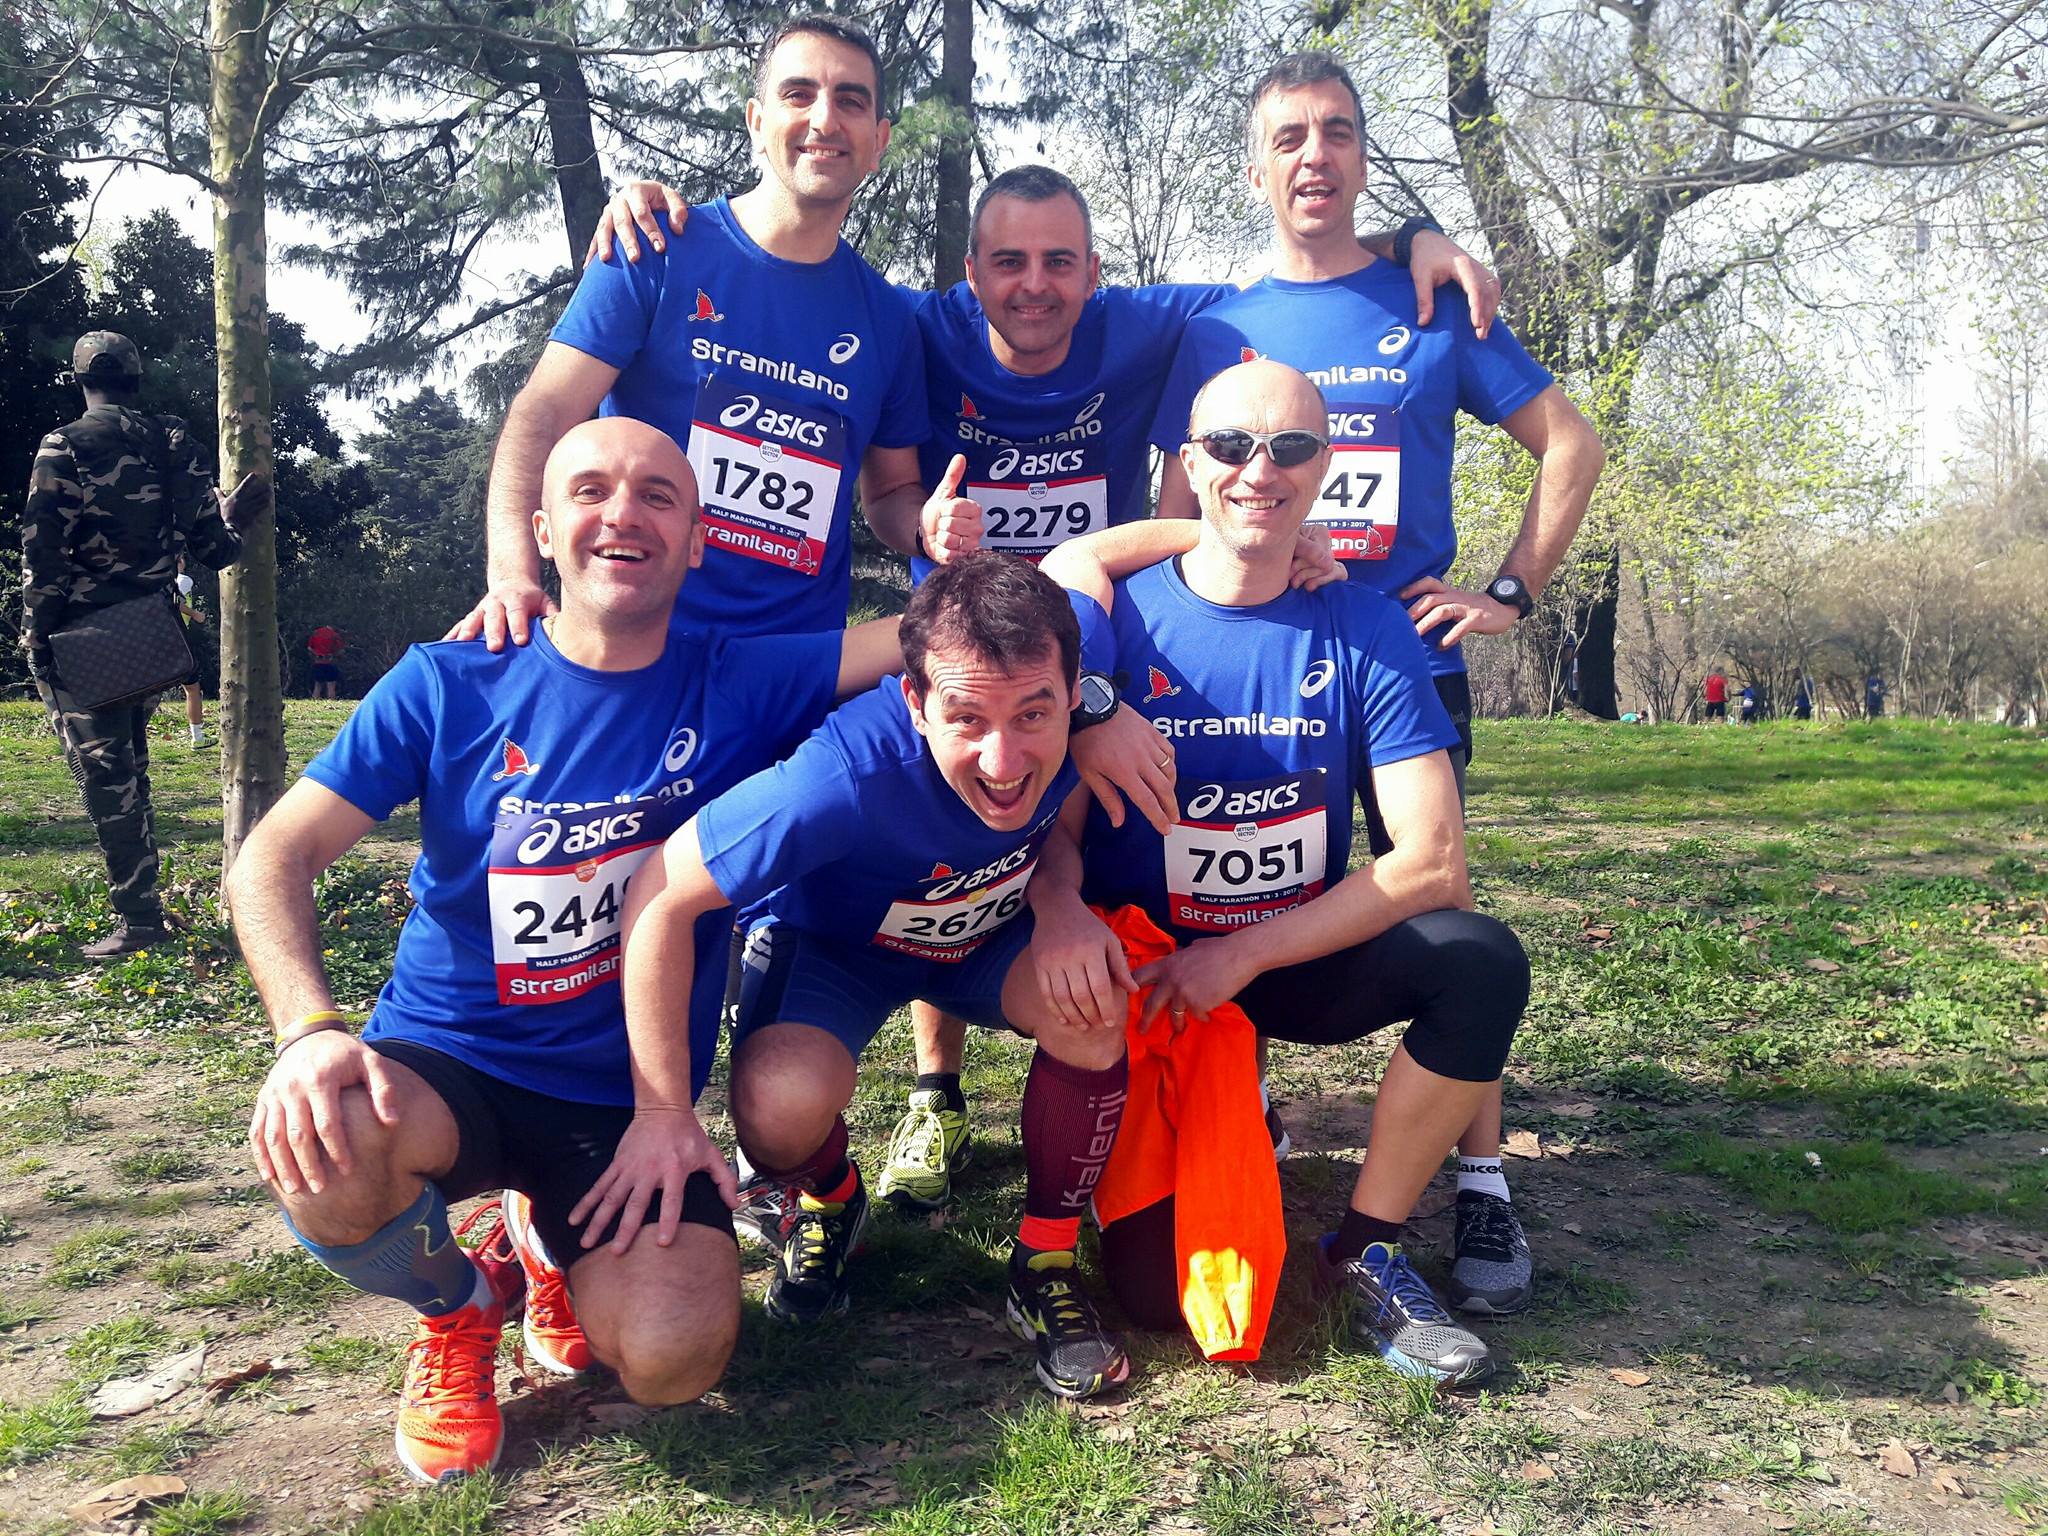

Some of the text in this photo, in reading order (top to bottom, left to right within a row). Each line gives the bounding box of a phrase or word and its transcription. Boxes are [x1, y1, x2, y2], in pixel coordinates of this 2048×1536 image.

[691, 337, 849, 401] Stramilano
[1304, 365, 1407, 386] milano
[755, 406, 828, 448] asics
[1327, 412, 1377, 437] sics
[1020, 449, 1084, 476] asics
[712, 457, 814, 521] 1782
[1322, 471, 1382, 508] 47
[711, 508, 729, 518] HALF
[729, 513, 767, 528] MARATHON
[986, 501, 1091, 538] 2279
[705, 524, 798, 561] ramilano
[1153, 713, 1326, 737] Stramilano
[1224, 781, 1300, 815] asics
[562, 811, 644, 854] asics
[964, 844, 1030, 889] asics
[1188, 838, 1303, 885] 7051
[902, 888, 1022, 937] 2676
[510, 955, 620, 995] Stramilan
[536, 945, 600, 968] HALF MARATHON
